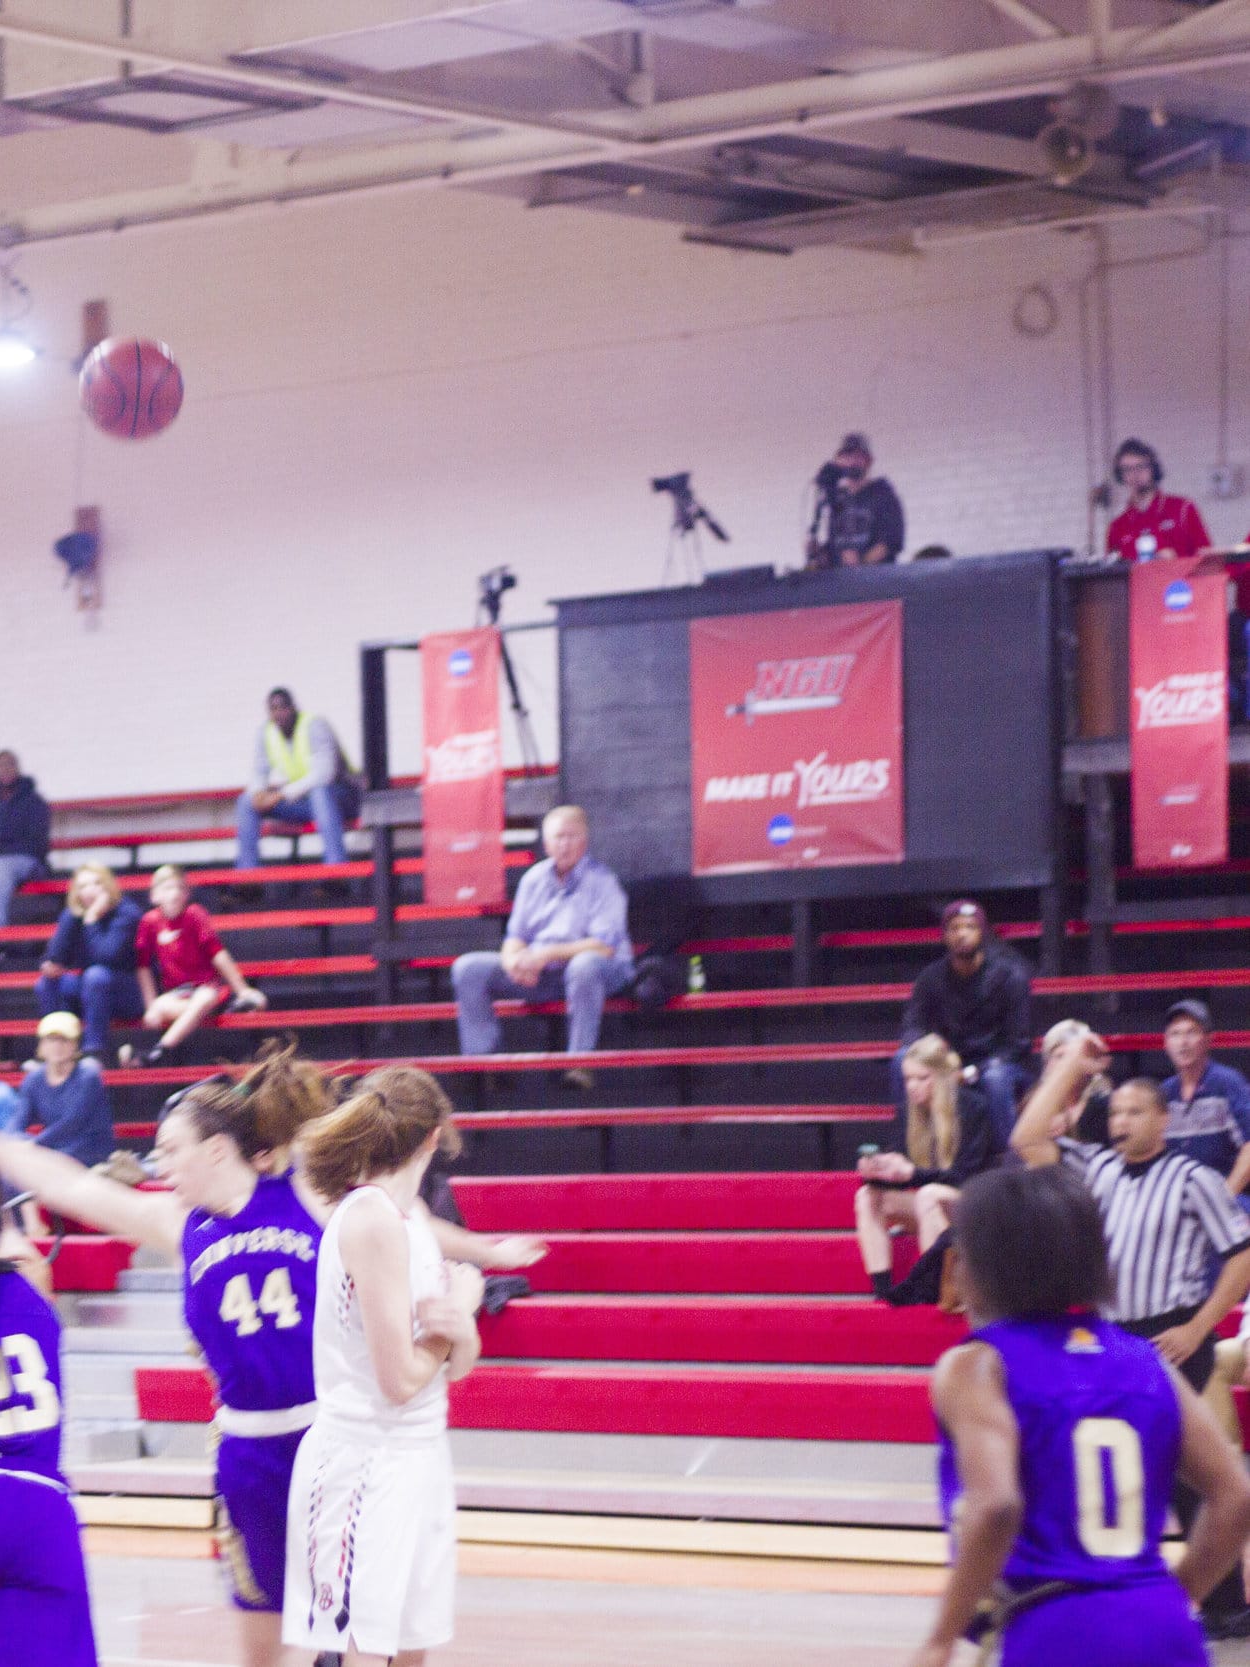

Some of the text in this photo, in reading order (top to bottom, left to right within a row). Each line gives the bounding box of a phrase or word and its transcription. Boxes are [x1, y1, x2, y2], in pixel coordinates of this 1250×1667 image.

[705, 752, 890, 808] MAKE IT YOURS
[218, 1266, 303, 1337] 44
[1073, 1418, 1145, 1557] 0
